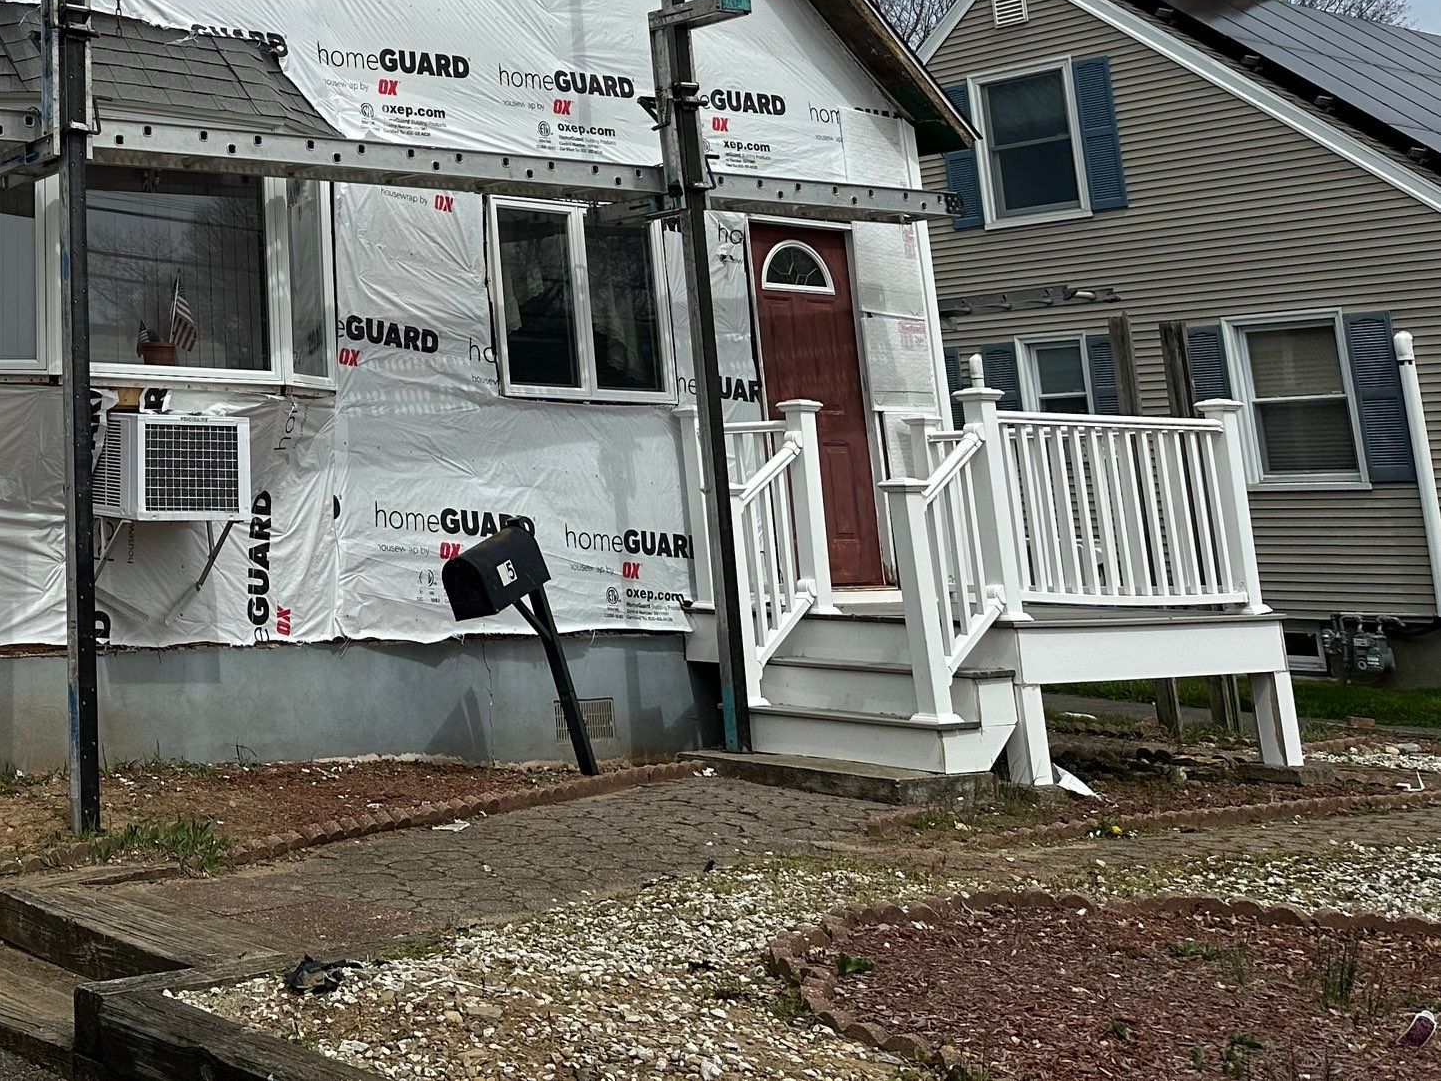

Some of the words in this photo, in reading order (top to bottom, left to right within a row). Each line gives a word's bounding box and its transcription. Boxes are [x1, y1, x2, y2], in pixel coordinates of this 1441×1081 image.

[317, 42, 470, 78] homeGUARD
[360, 82, 368, 92] by
[378, 79, 398, 96] OX
[499, 63, 634, 98] homeGUARD
[382, 104, 446, 119] oxep.com
[537, 101, 545, 111] by
[553, 99, 571, 115] OX
[558, 122, 615, 137] oxep.com
[712, 117, 728, 132] OX
[719, 140, 771, 152] xep.com
[381, 187, 418, 204] housewrap
[419, 197, 428, 206] by
[435, 195, 453, 212] OX
[339, 348, 360, 367] OX
[421, 547, 430, 556] by
[440, 542, 461, 559] OX
[507, 561, 516, 580] 5
[623, 562, 640, 579] OX
[626, 588, 684, 602] oxep.com
[276, 606, 291, 636] OX
